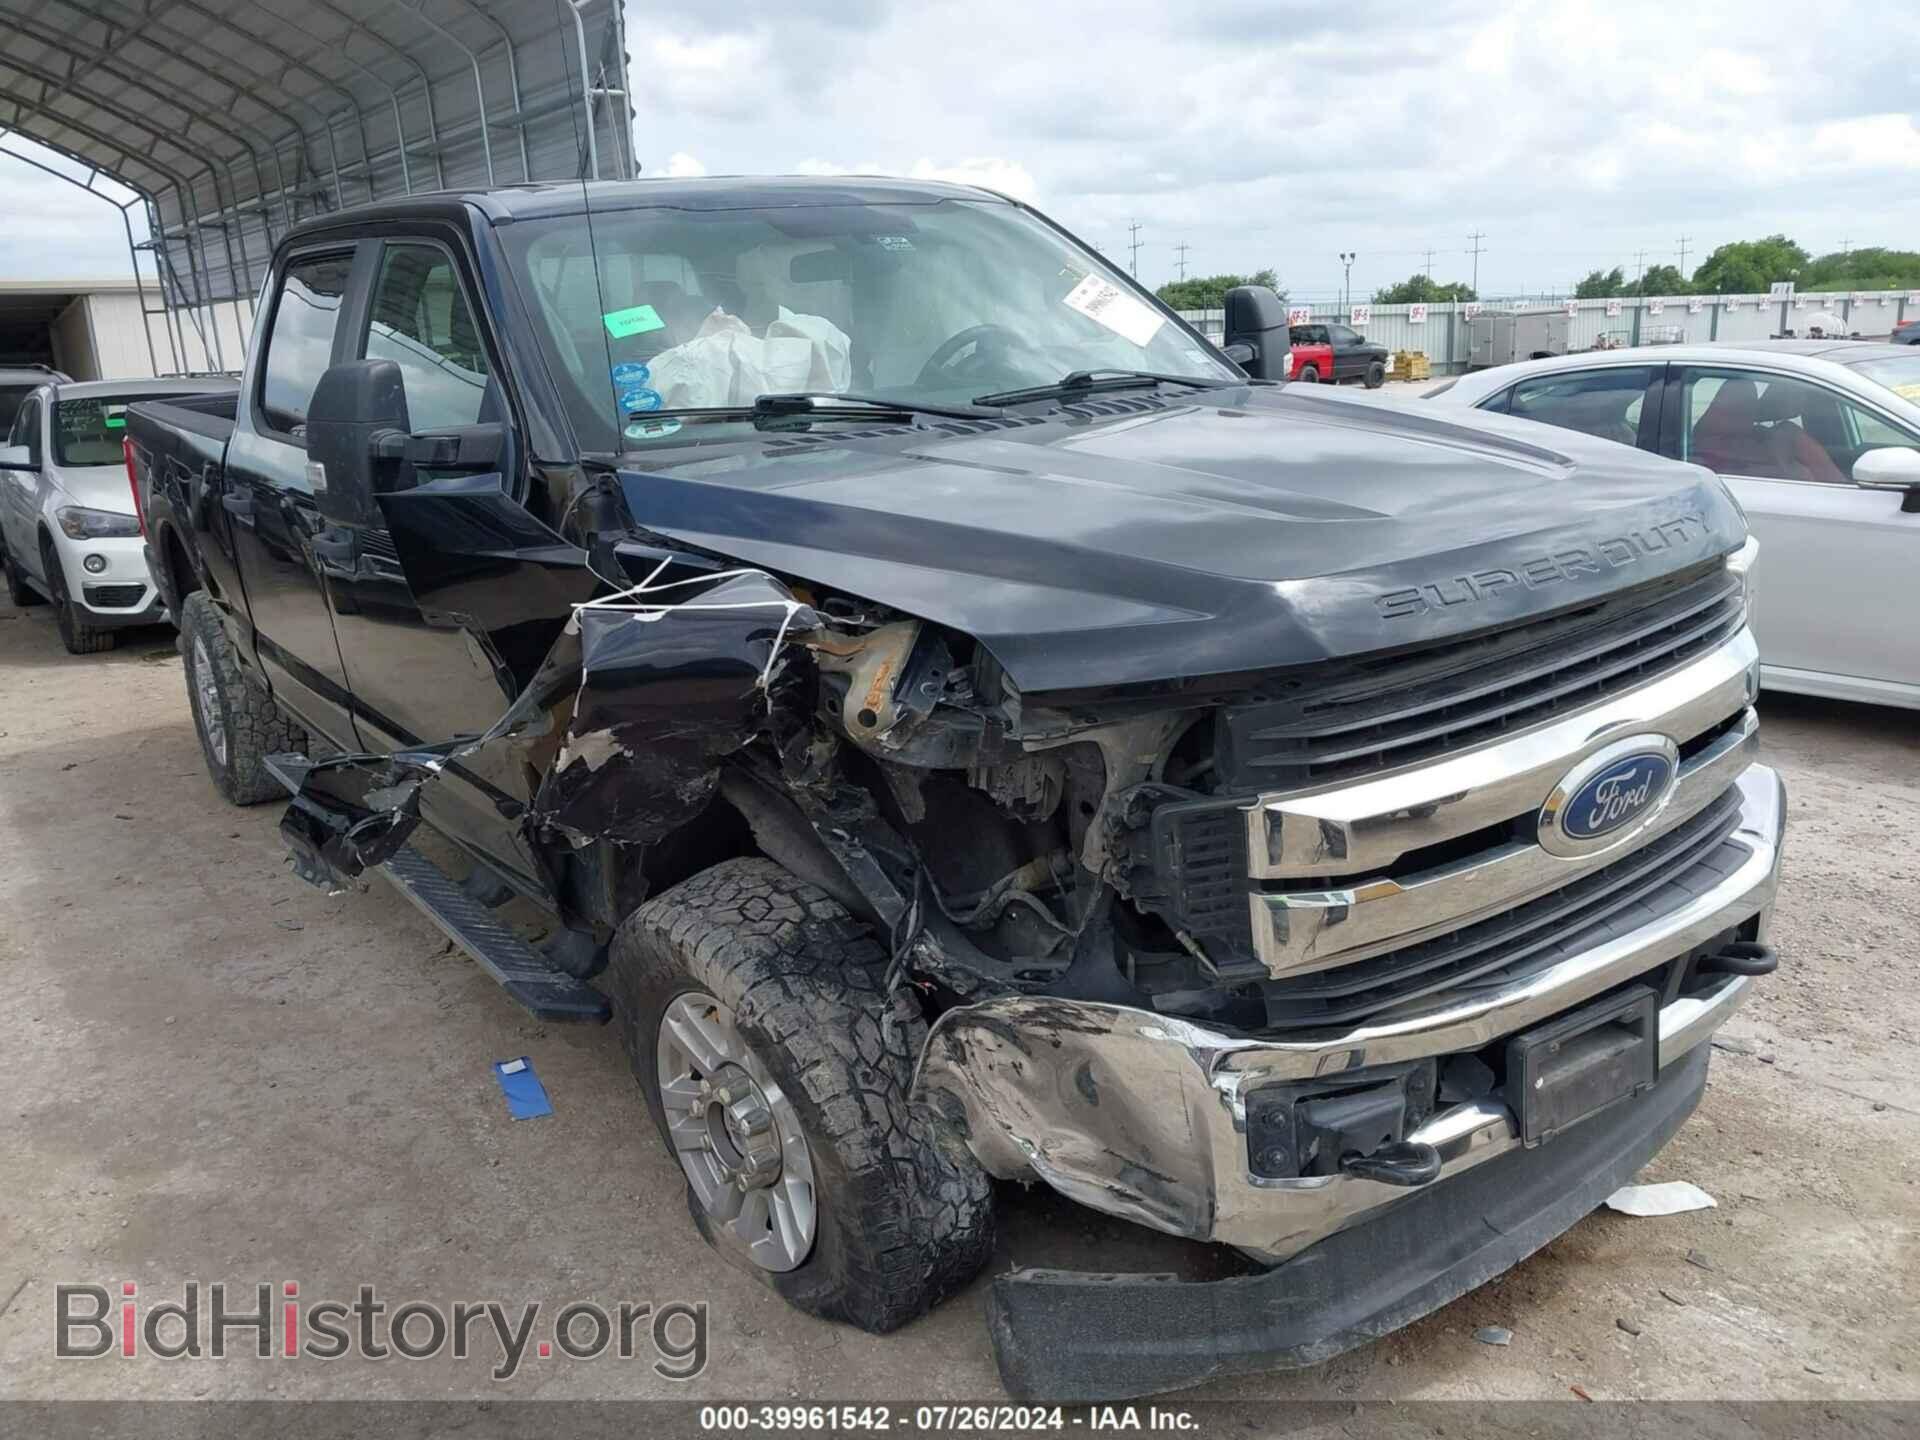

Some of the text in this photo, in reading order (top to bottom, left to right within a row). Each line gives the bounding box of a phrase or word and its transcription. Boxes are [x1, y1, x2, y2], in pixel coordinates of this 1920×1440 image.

[1375, 511, 1710, 619] SUPER DUTY
[1589, 768, 1652, 829] Ford
